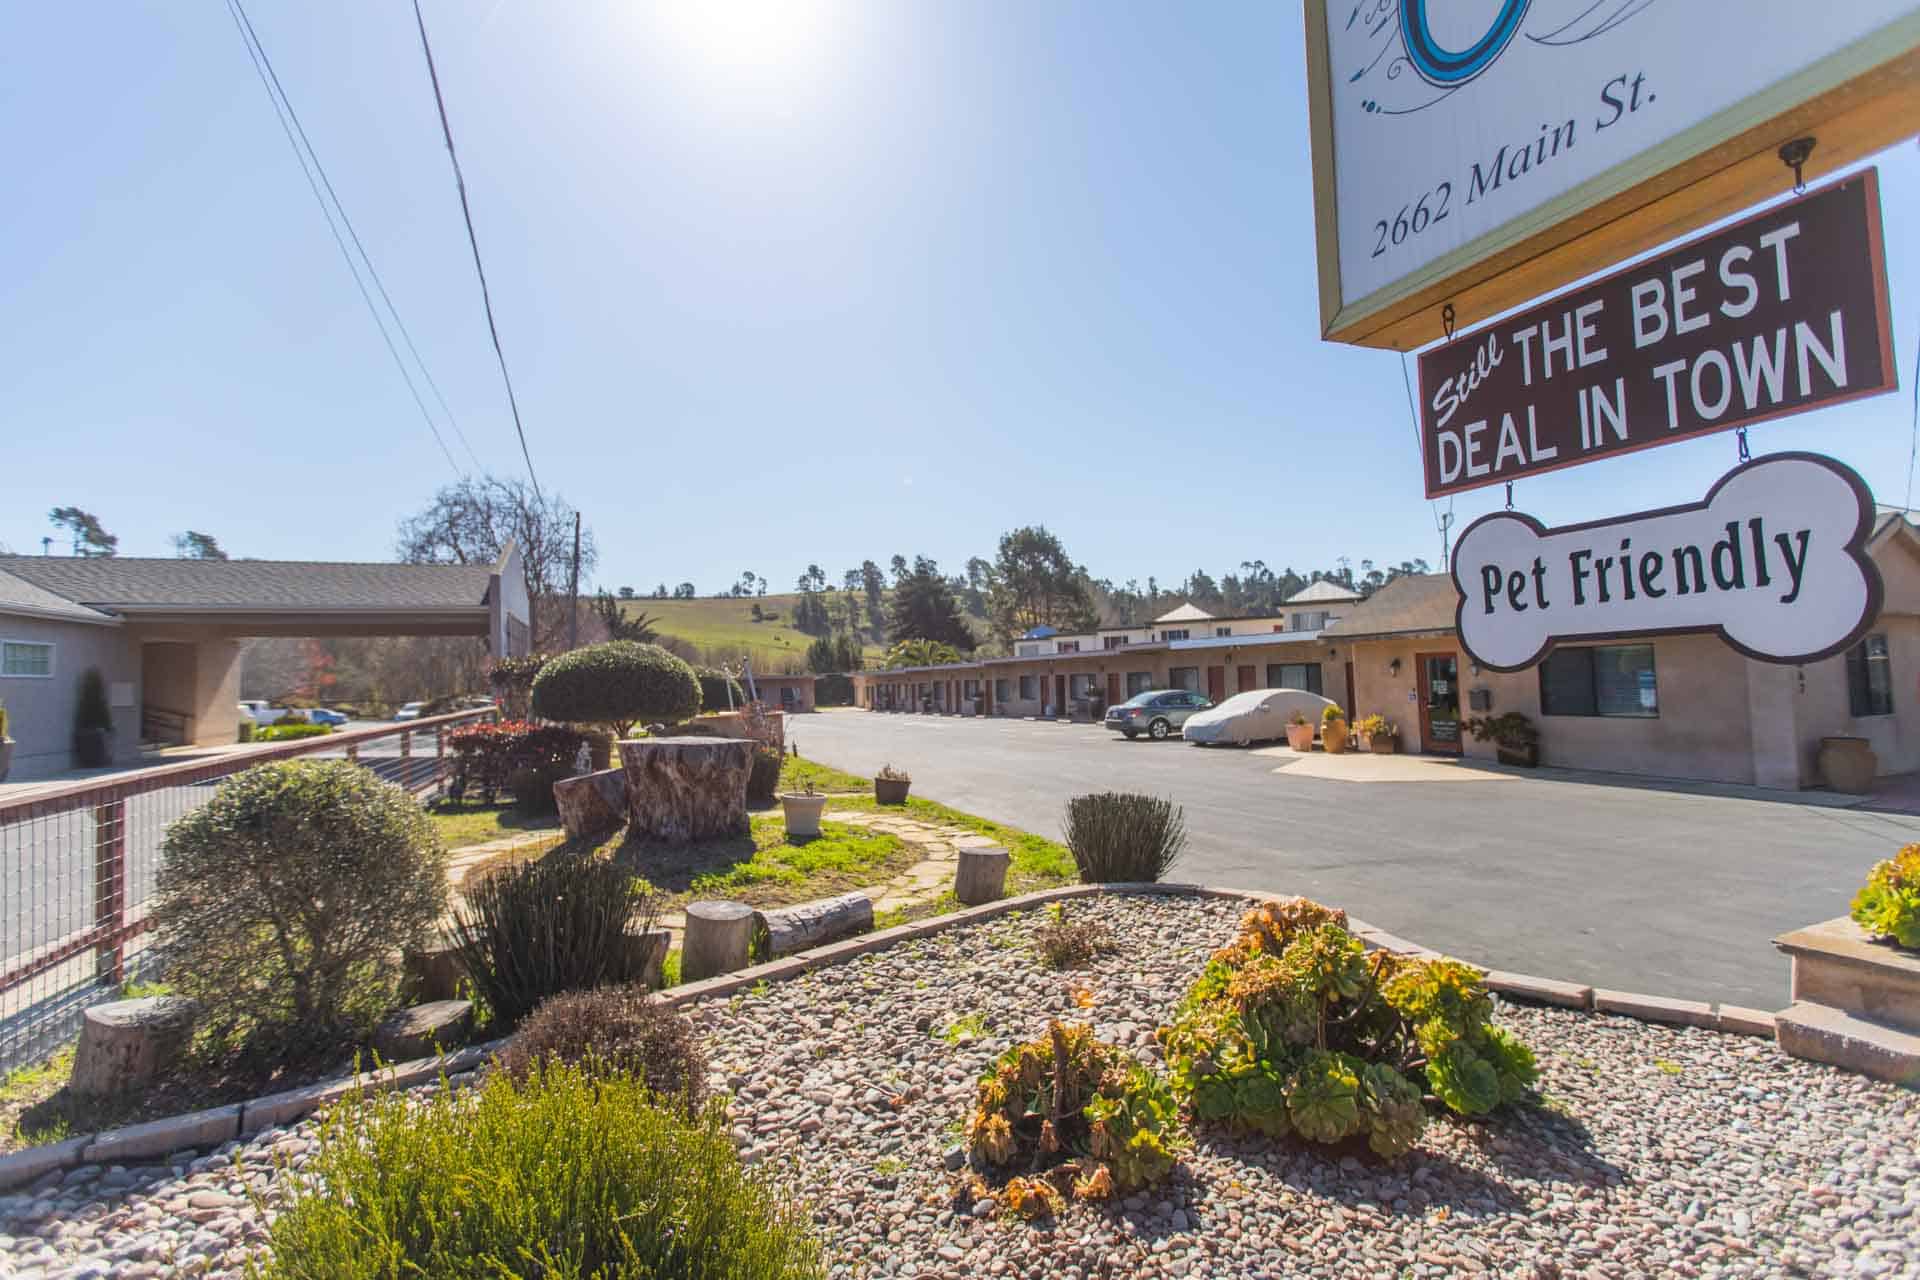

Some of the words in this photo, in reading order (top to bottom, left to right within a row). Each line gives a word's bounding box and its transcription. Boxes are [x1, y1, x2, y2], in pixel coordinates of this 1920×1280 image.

[1371, 182, 1451, 258] 2662
[1467, 118, 1576, 206] Main
[1595, 71, 1657, 132] St.
[1432, 335, 1504, 427] Still
[1513, 300, 1608, 386] THE
[1632, 222, 1800, 349] BEST
[1437, 405, 1557, 484] DEAL
[1579, 378, 1630, 450] IN
[1654, 311, 1848, 428] TOWN
[1481, 556, 1550, 615] Pet
[1569, 517, 1811, 605] Friendly
